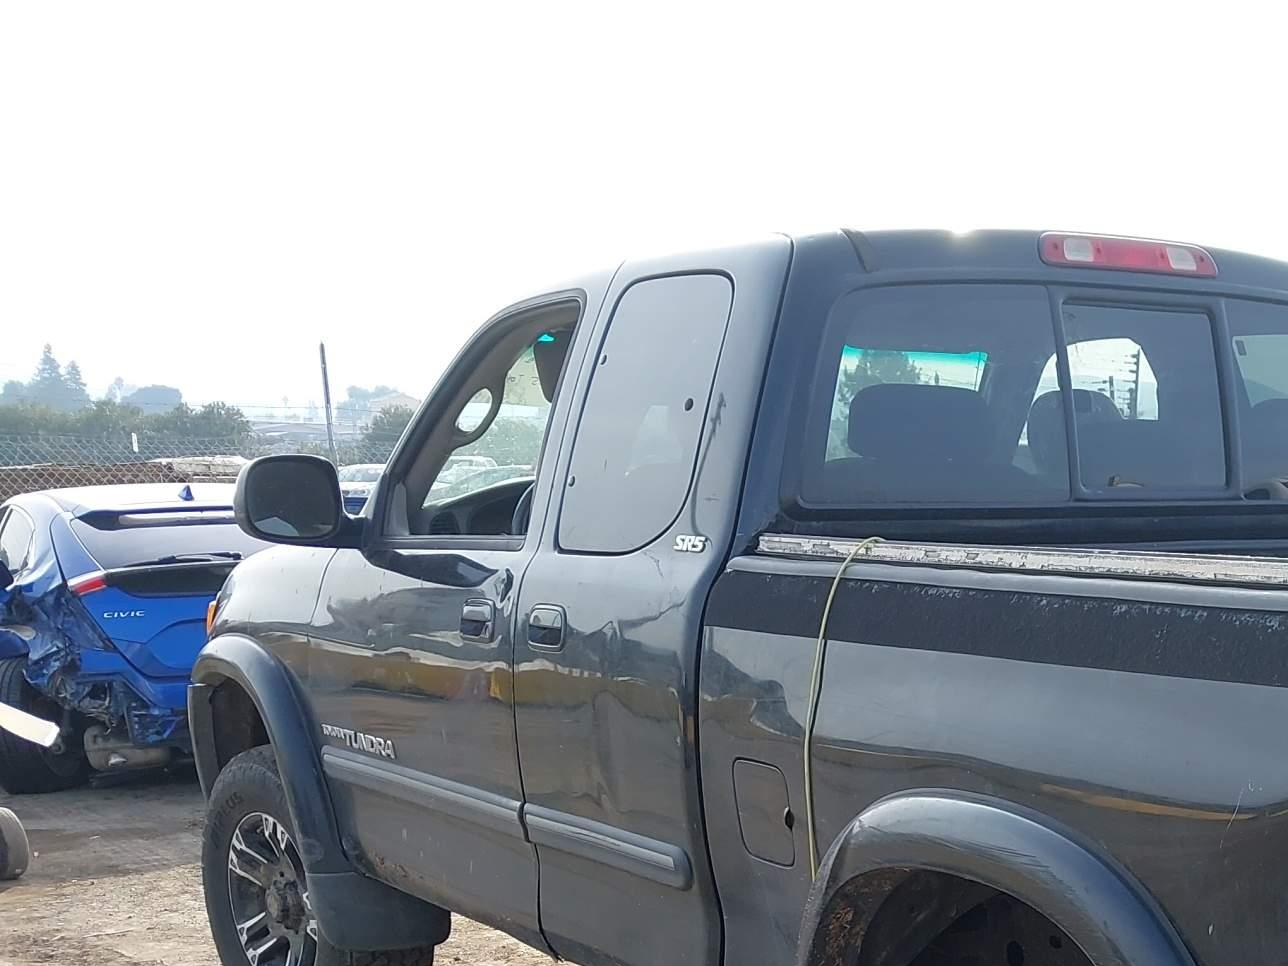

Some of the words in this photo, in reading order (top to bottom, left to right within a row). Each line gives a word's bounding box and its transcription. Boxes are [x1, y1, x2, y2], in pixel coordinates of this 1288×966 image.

[673, 535, 706, 552] SR5
[103, 610, 145, 618] CIVIC
[342, 729, 395, 759] TUNDRA
